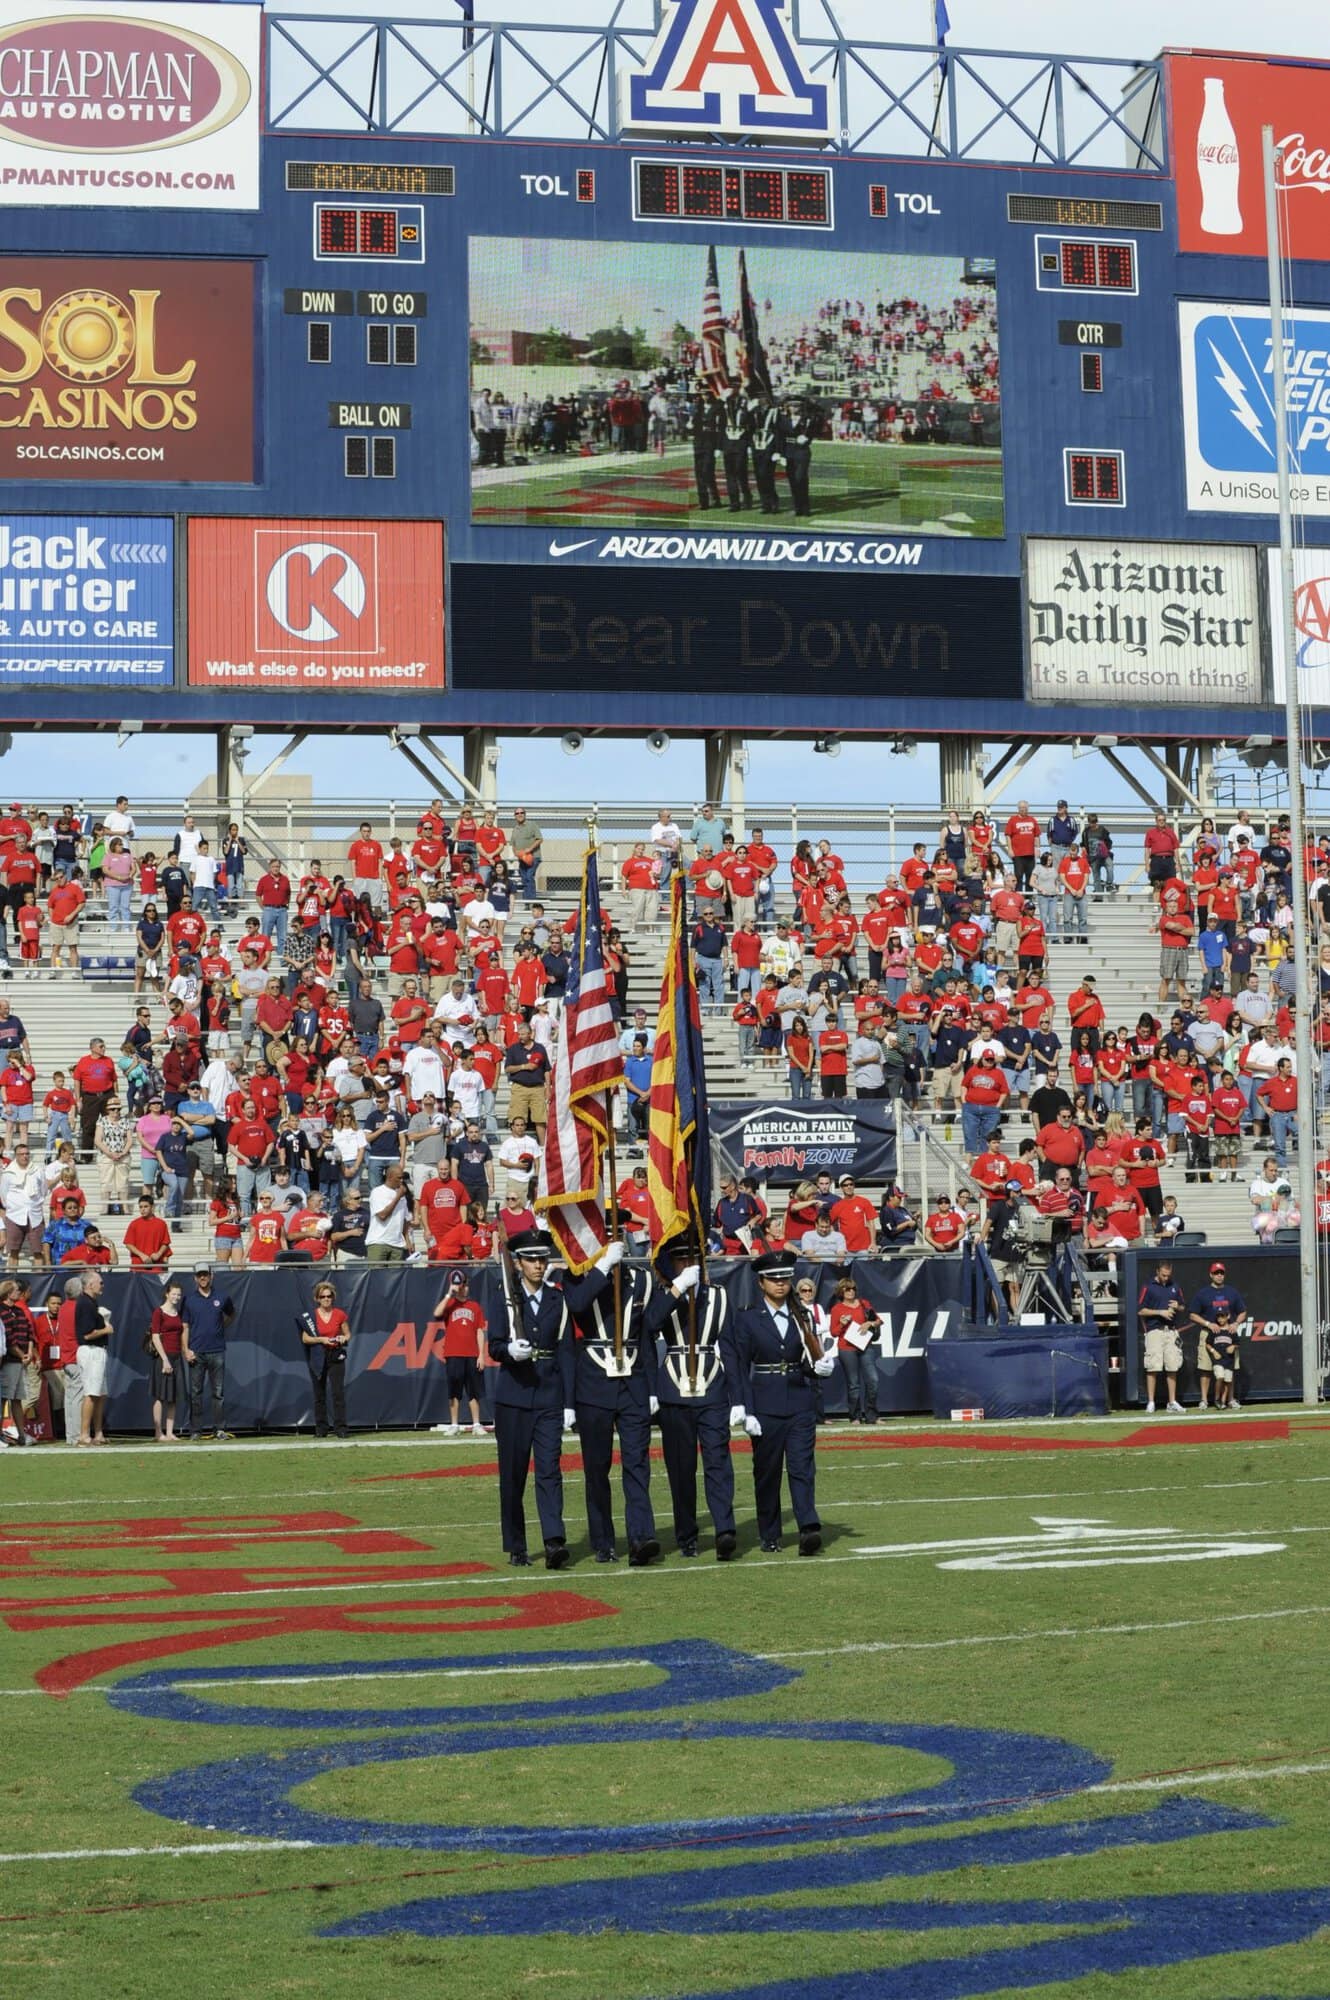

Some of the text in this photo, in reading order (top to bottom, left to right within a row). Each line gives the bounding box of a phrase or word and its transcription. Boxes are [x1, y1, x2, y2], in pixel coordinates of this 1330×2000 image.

[0, 48, 196, 101] CHAPMAN
[0, 101, 191, 122] AUTOMOTIVE
[0, 168, 236, 190] PMANTUCSON.COM
[313, 164, 426, 192] ARIZONA
[520, 174, 569, 196] TOL
[894, 193, 941, 215] TOL
[302, 292, 336, 313] DWN
[369, 293, 415, 315] TO GO
[1077, 323, 1104, 344] QTR
[338, 405, 400, 427] BALL ON
[16, 445, 164, 461] SOLCASINOS.COM
[1200, 481, 1213, 497] A
[599, 536, 923, 566] ARIZONAWILDCATS.COM
[1054, 548, 1226, 596] Arizona
[20, 620, 86, 637] AUTO
[93, 621, 158, 638] CARE
[531, 595, 950, 671] Bear Down
[1029, 599, 1254, 658] Daily Star
[207, 661, 426, 681] What else do you need?
[1033, 663, 1255, 693] It's a Tucson thing.
[302, 1018, 311, 1035] 7
[326, 1018, 344, 1034] 35
[744, 1120, 854, 1134] AMERICAN FAMILY
[752, 1134, 847, 1144] INSURANCE
